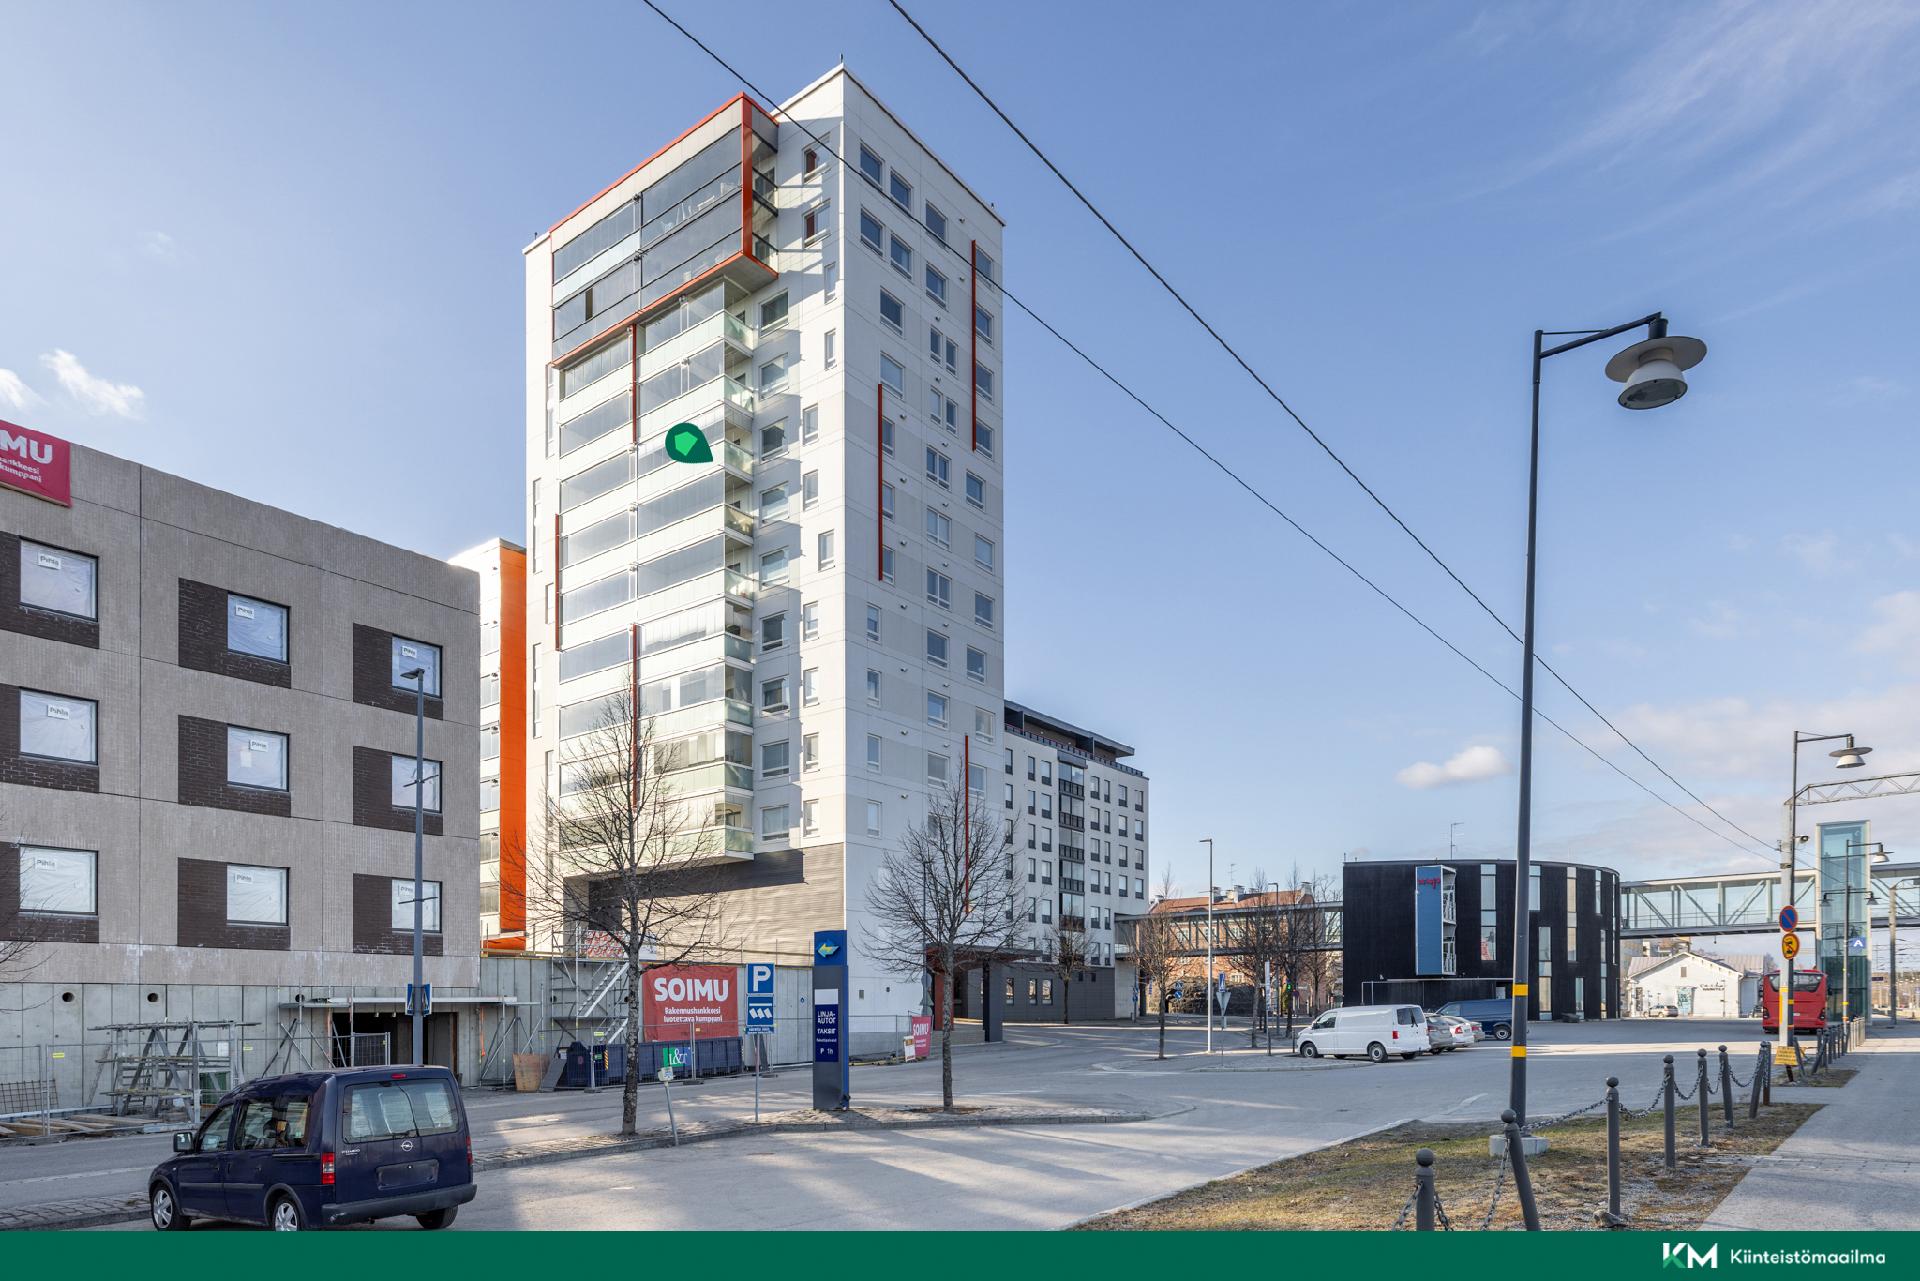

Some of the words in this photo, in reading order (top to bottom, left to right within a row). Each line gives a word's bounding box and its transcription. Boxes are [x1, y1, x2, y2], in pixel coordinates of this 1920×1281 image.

[653, 977, 729, 1002] SOIMU
[753, 965, 772, 992] P
[913, 1023, 929, 1036] SOIMU
